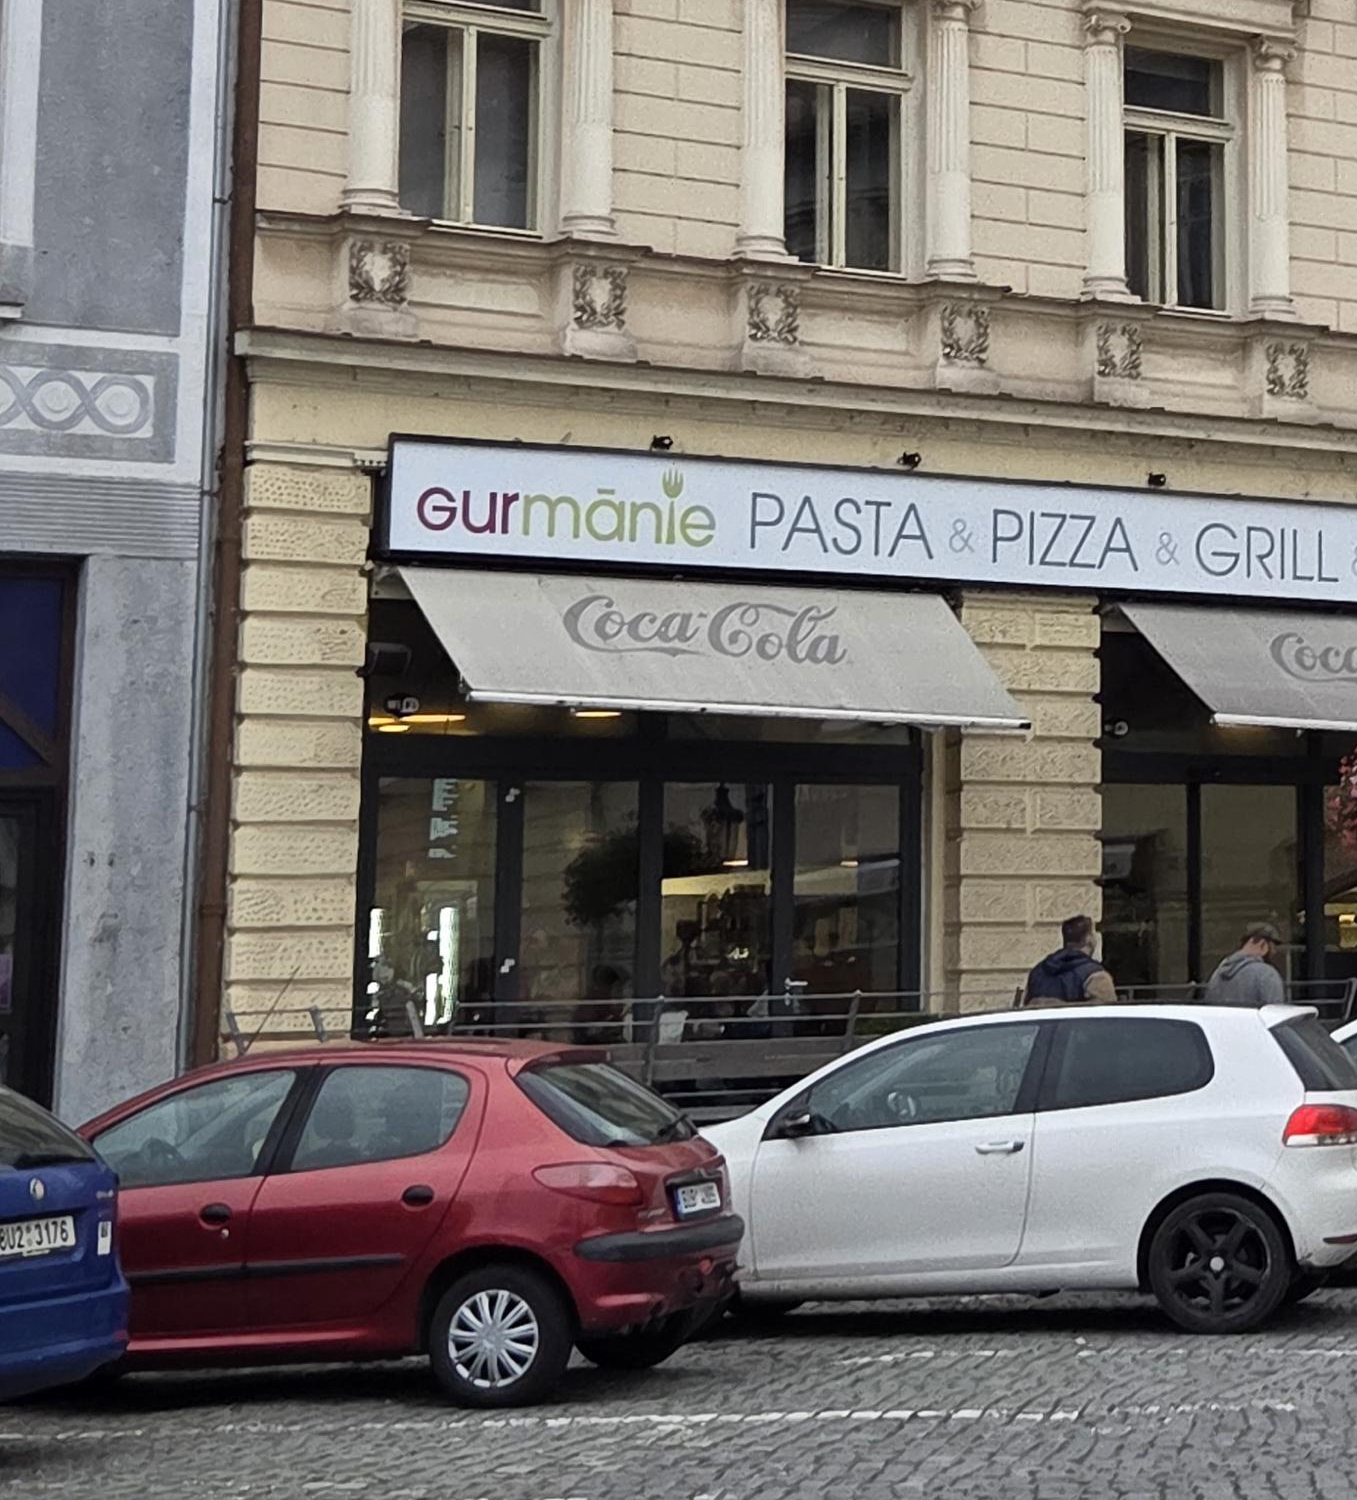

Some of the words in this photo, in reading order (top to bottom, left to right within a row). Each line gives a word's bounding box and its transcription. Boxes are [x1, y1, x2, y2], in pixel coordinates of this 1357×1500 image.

[750, 491, 933, 560] PASTA
[948, 518, 975, 553] &
[991, 509, 1139, 572] PIZZA
[1155, 532, 1180, 566] &
[1195, 523, 1339, 583] GRILL
[34, 1219, 69, 1246] 3176
